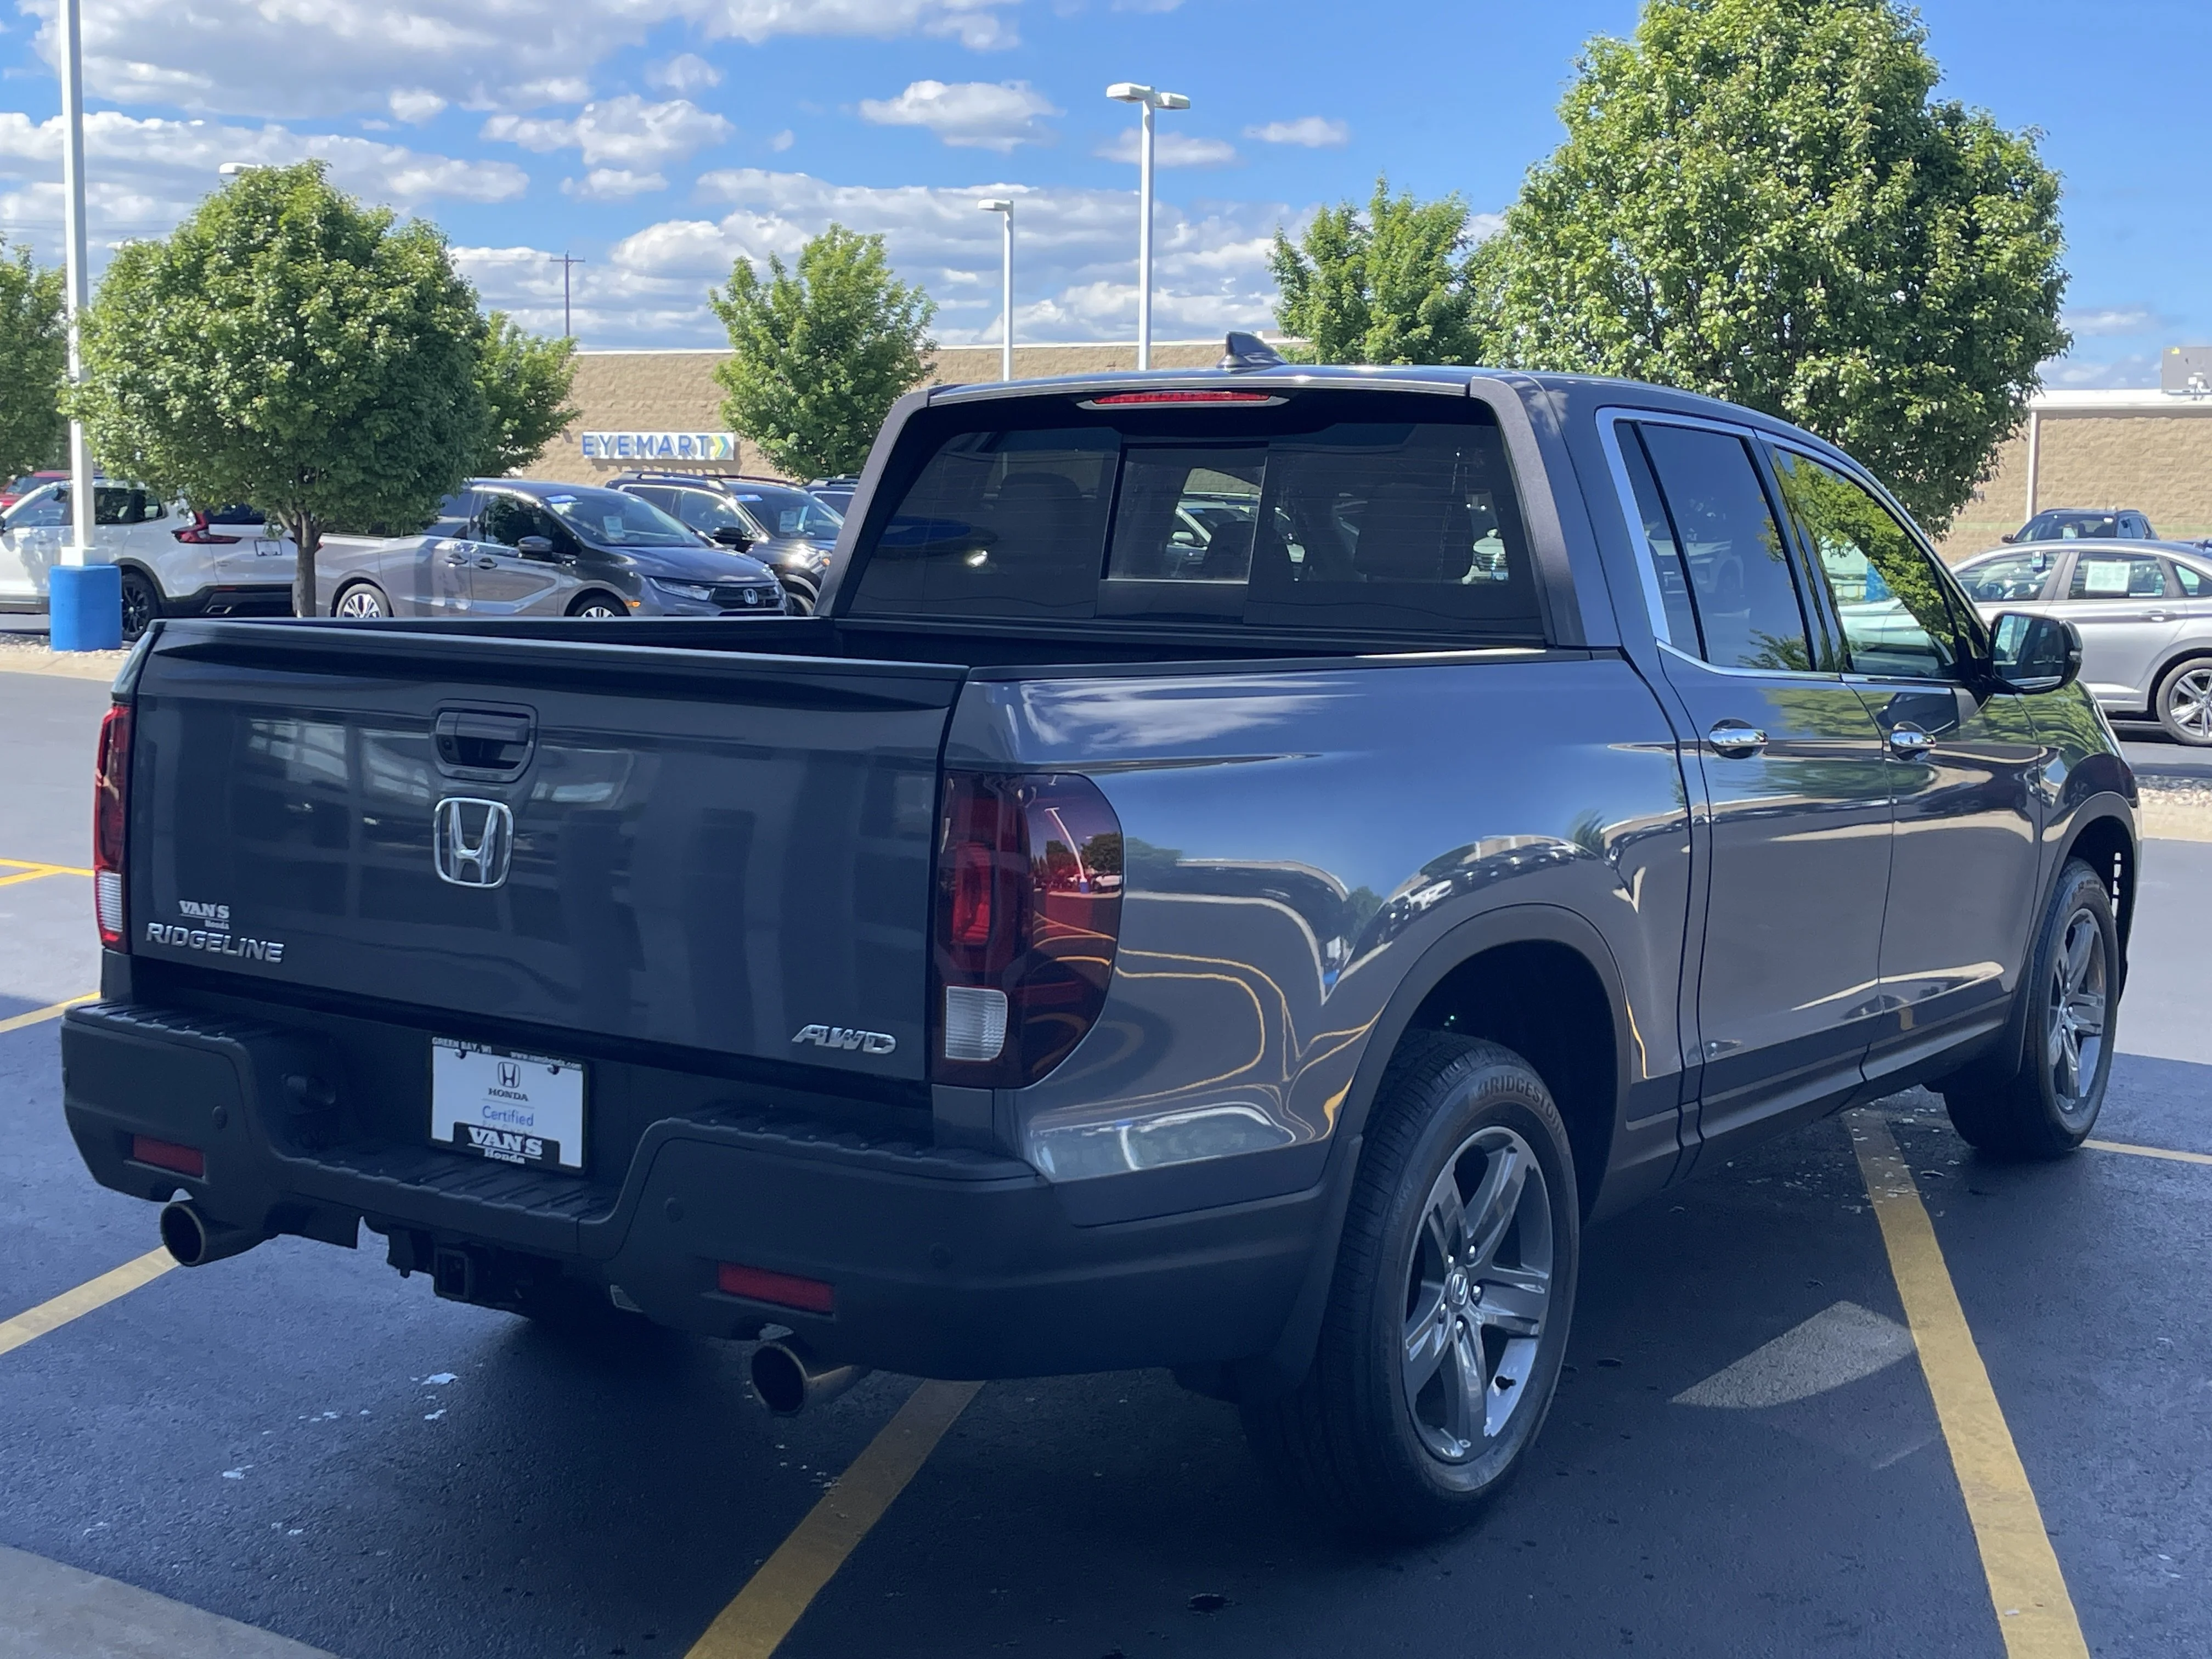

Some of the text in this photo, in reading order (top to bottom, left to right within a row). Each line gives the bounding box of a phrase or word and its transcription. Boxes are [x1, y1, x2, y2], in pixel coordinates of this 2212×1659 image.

[582, 434, 709, 456] EYEMART
[145, 922, 284, 963] RIDGELINE
[792, 1024, 896, 1054] AWD
[488, 1087, 529, 1102] HONDA
[482, 1105, 534, 1126] Certified
[484, 1147, 525, 1164] Honda
